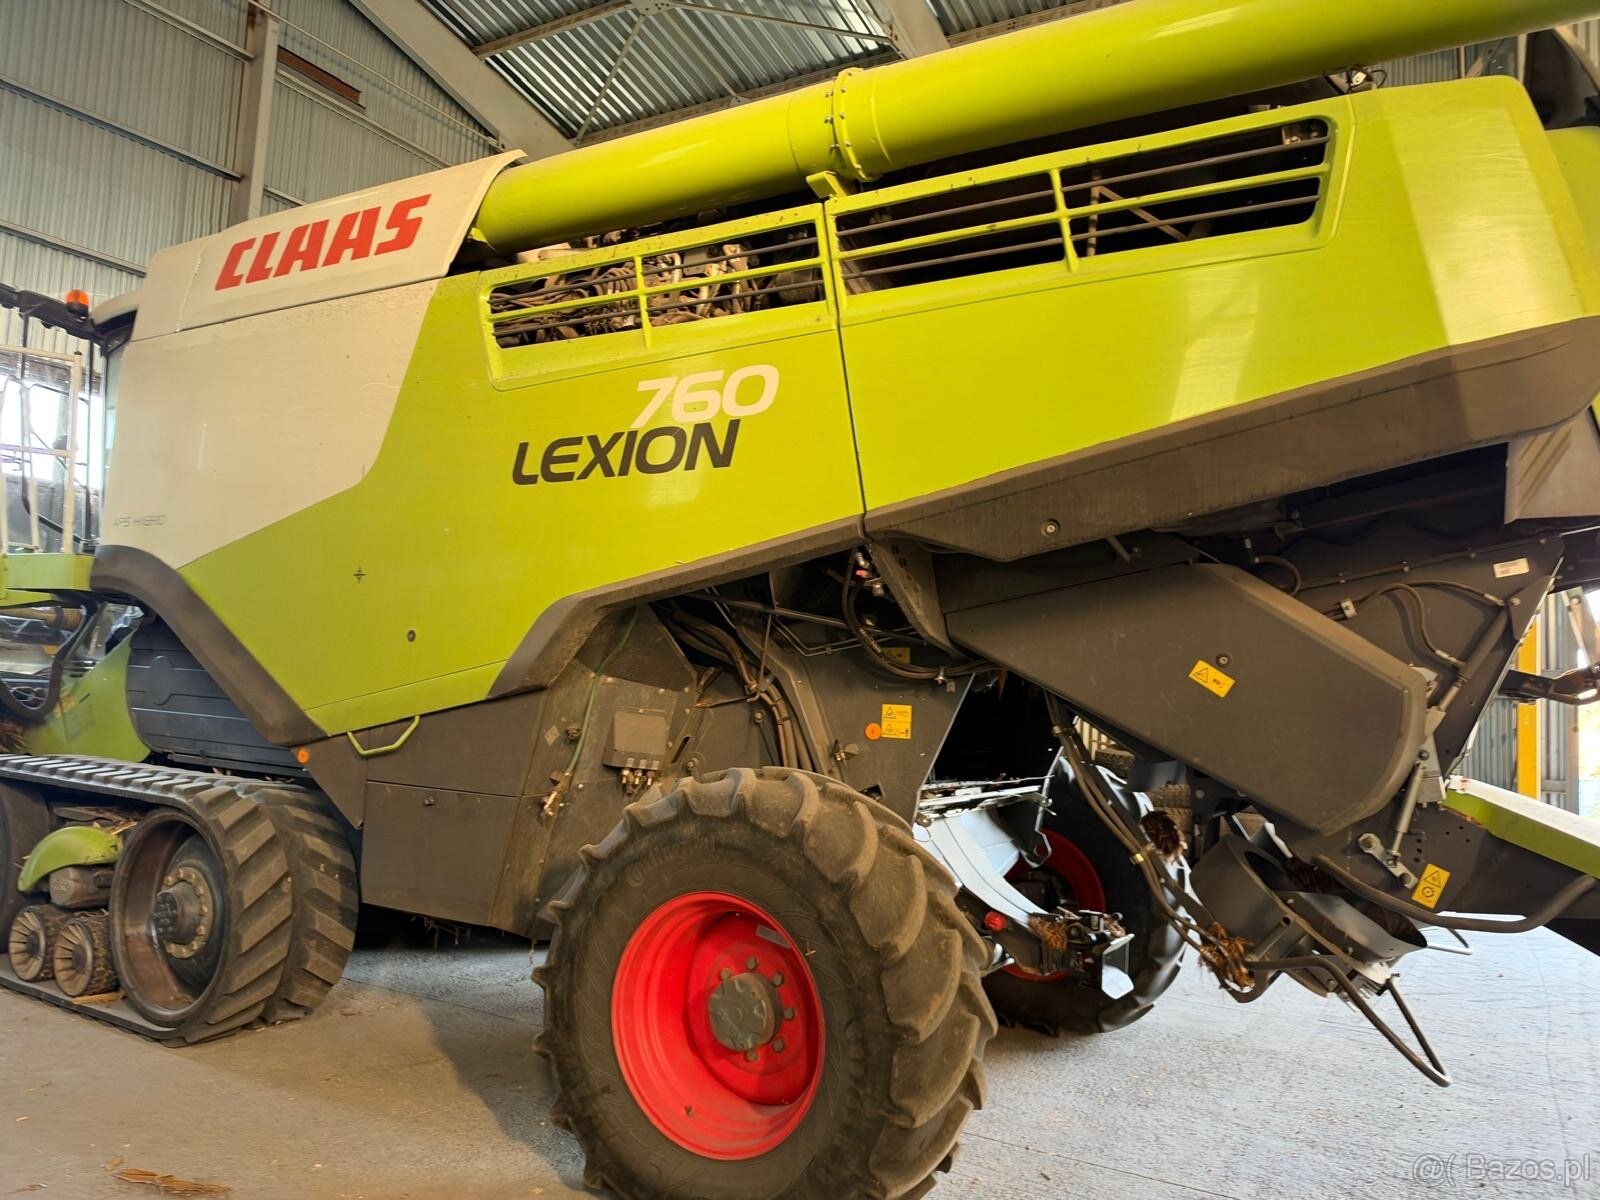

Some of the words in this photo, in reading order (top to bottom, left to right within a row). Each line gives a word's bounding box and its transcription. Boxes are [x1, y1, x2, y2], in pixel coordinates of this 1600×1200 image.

[214, 193, 433, 291] CLAAS
[629, 364, 780, 429] 760
[511, 418, 741, 486] LEXION
